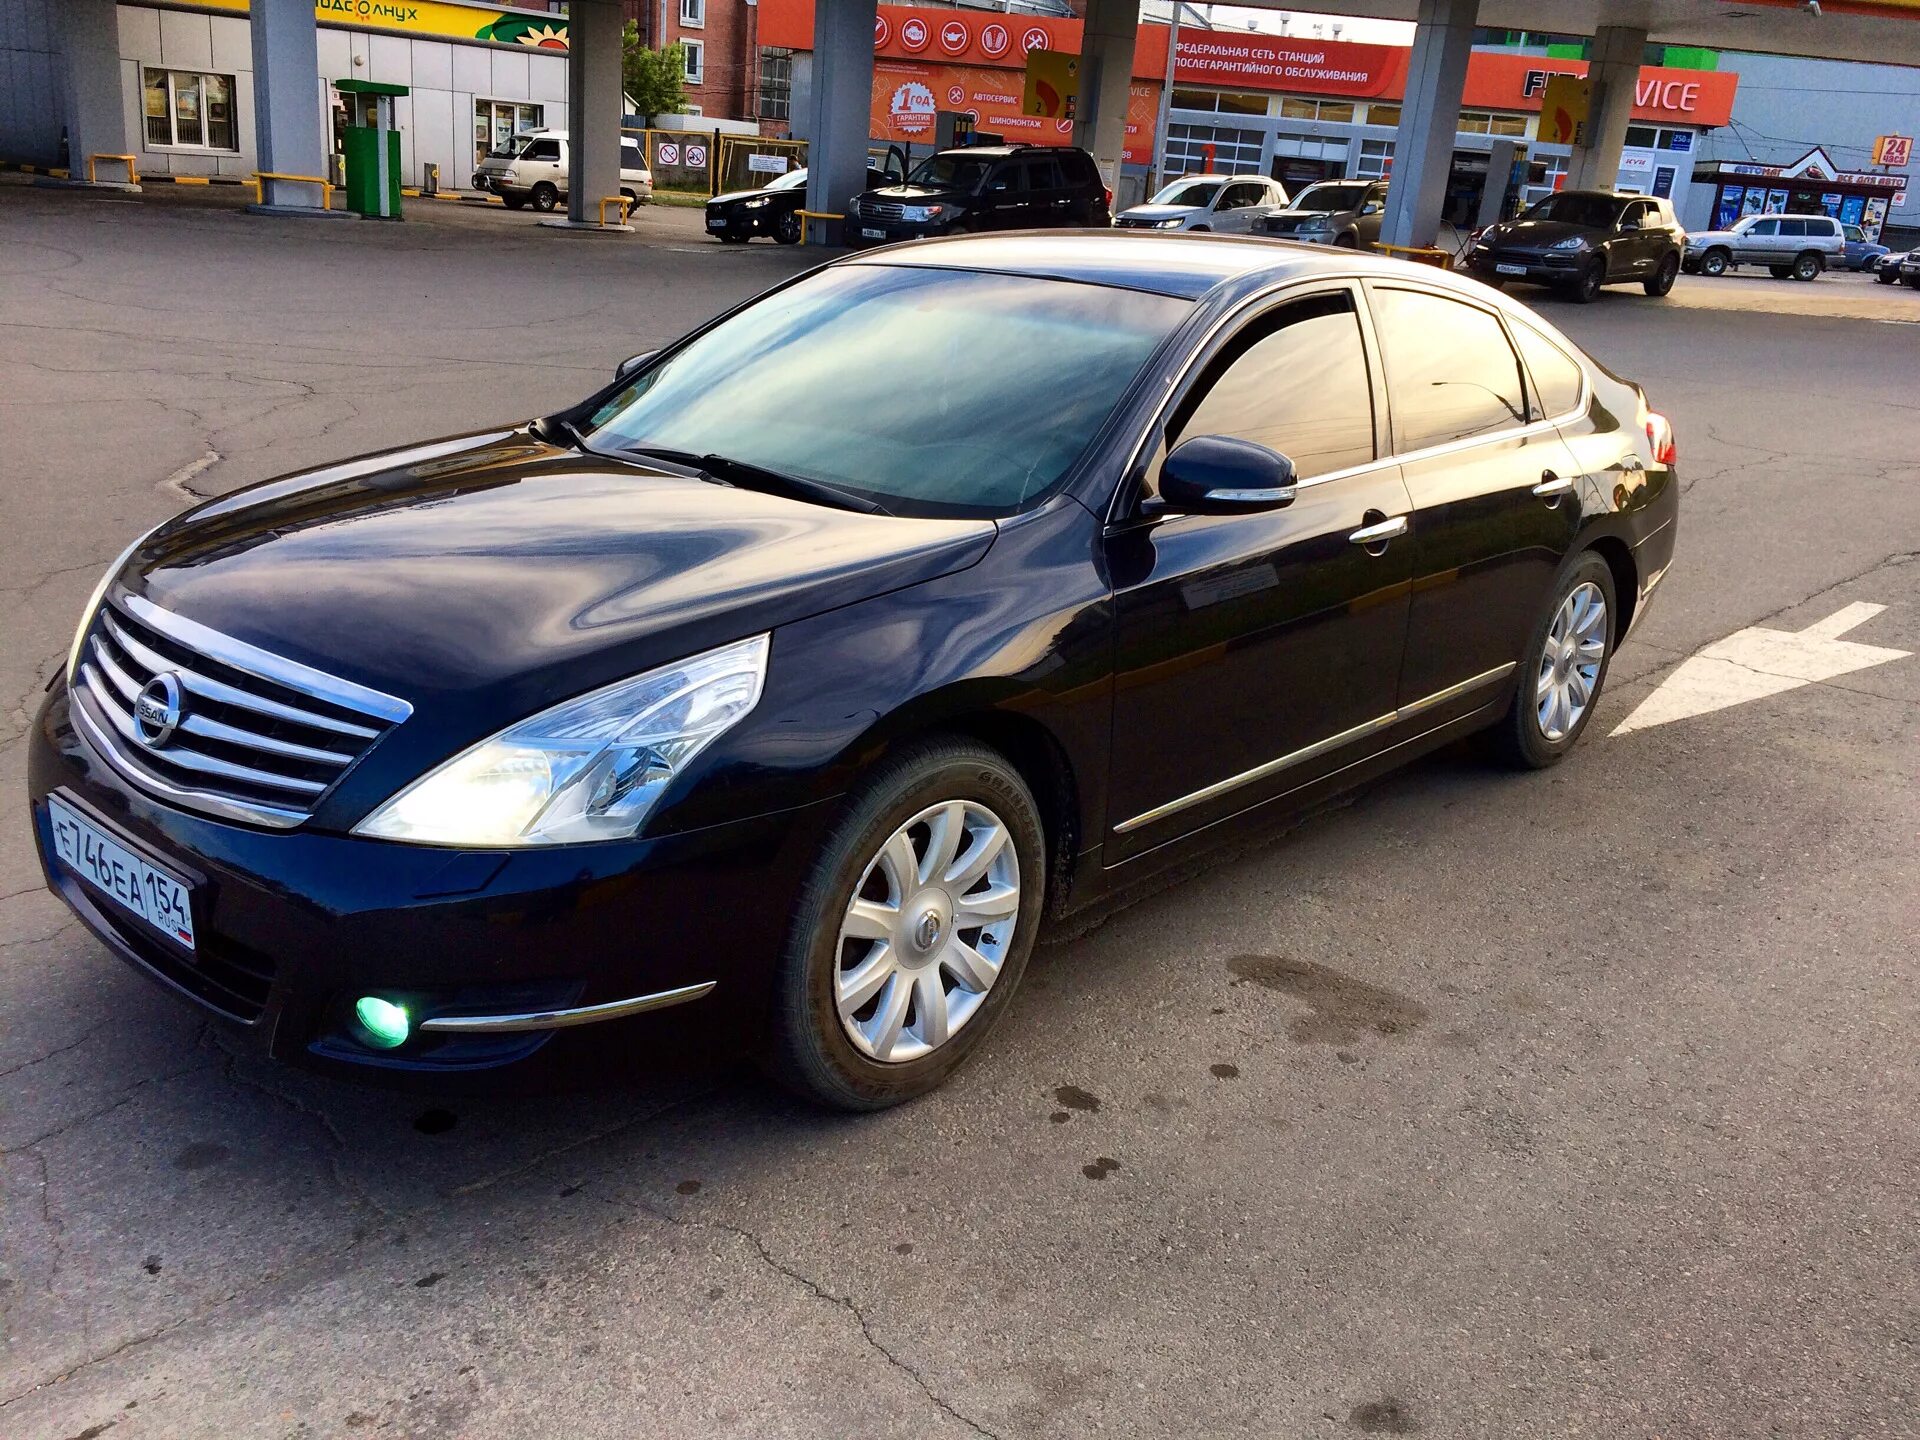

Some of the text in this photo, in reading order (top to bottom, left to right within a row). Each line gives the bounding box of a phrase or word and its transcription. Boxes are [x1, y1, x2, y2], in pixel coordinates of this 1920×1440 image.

[1175, 42, 1325, 65] ФЕДЕРАЛЬНАЯ СЕТЬ СТАНЦИЙ
[1284, 66, 1369, 83] ОБСЛУЖИВАНИЯ
[972, 91, 1018, 105] АВТОСЕРВИС
[1635, 79, 1701, 112] VICE
[896, 113, 931, 122] ГАРАНТИЯ
[988, 115, 1042, 129] ШИНОМОНТАЖ
[1887, 139, 1906, 155] 24
[1837, 174, 1854, 184] ВСЕ
[145, 871, 187, 926] 154
[157, 910, 178, 934] RUS
